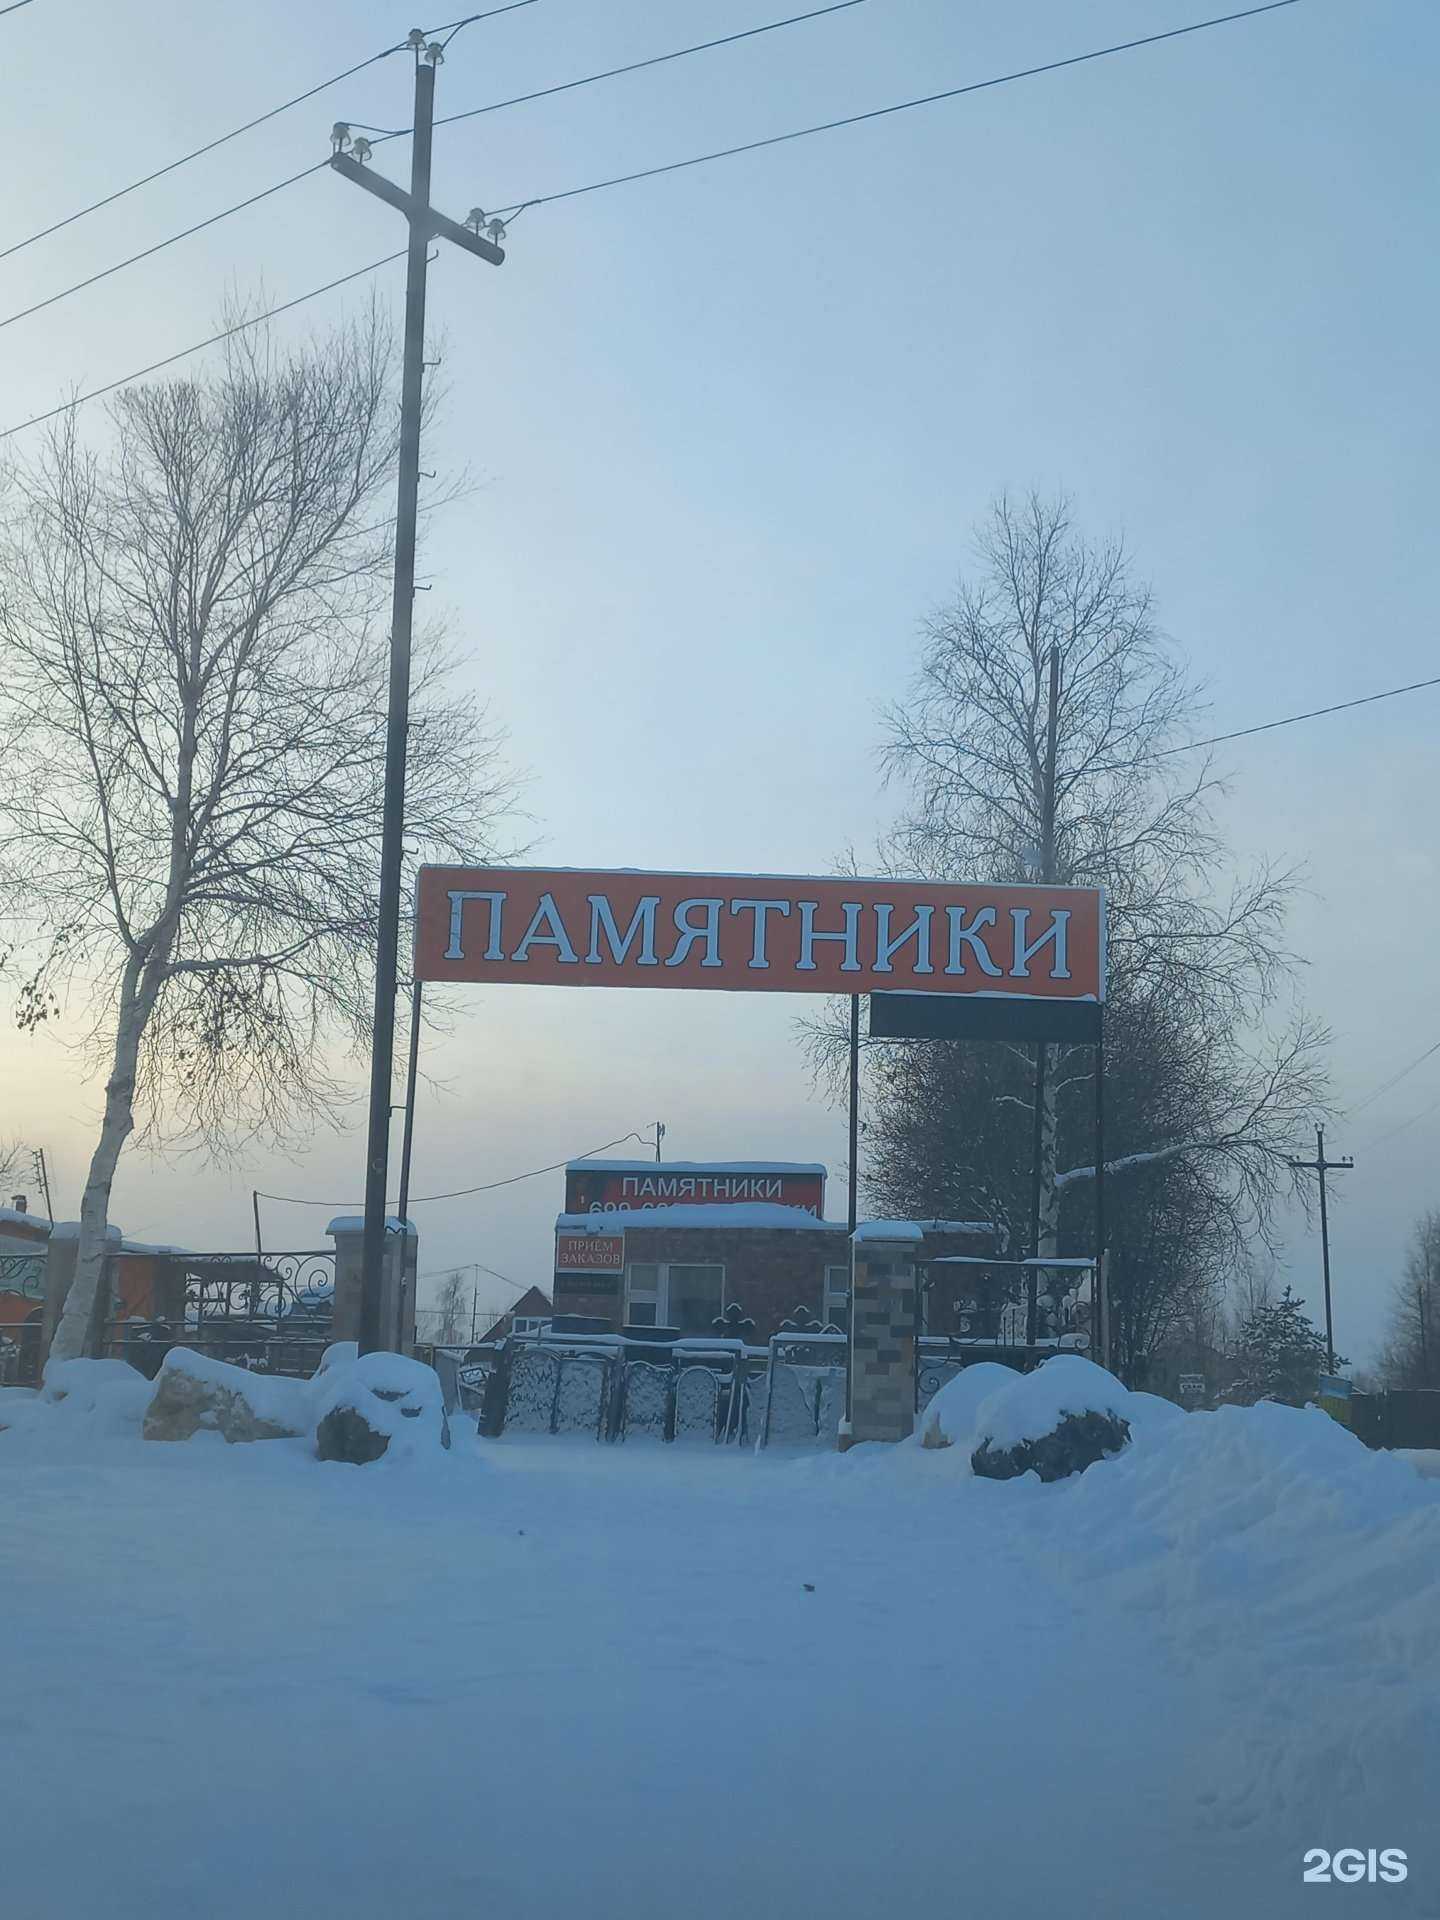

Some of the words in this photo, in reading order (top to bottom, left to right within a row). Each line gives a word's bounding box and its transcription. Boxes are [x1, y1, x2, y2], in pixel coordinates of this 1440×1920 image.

[444, 890, 1072, 979] ПАМЯТНИКИ
[622, 1177, 783, 1198] ПАМЯТНИКИ
[561, 1253, 620, 1265] ЗАКАЗОВ
